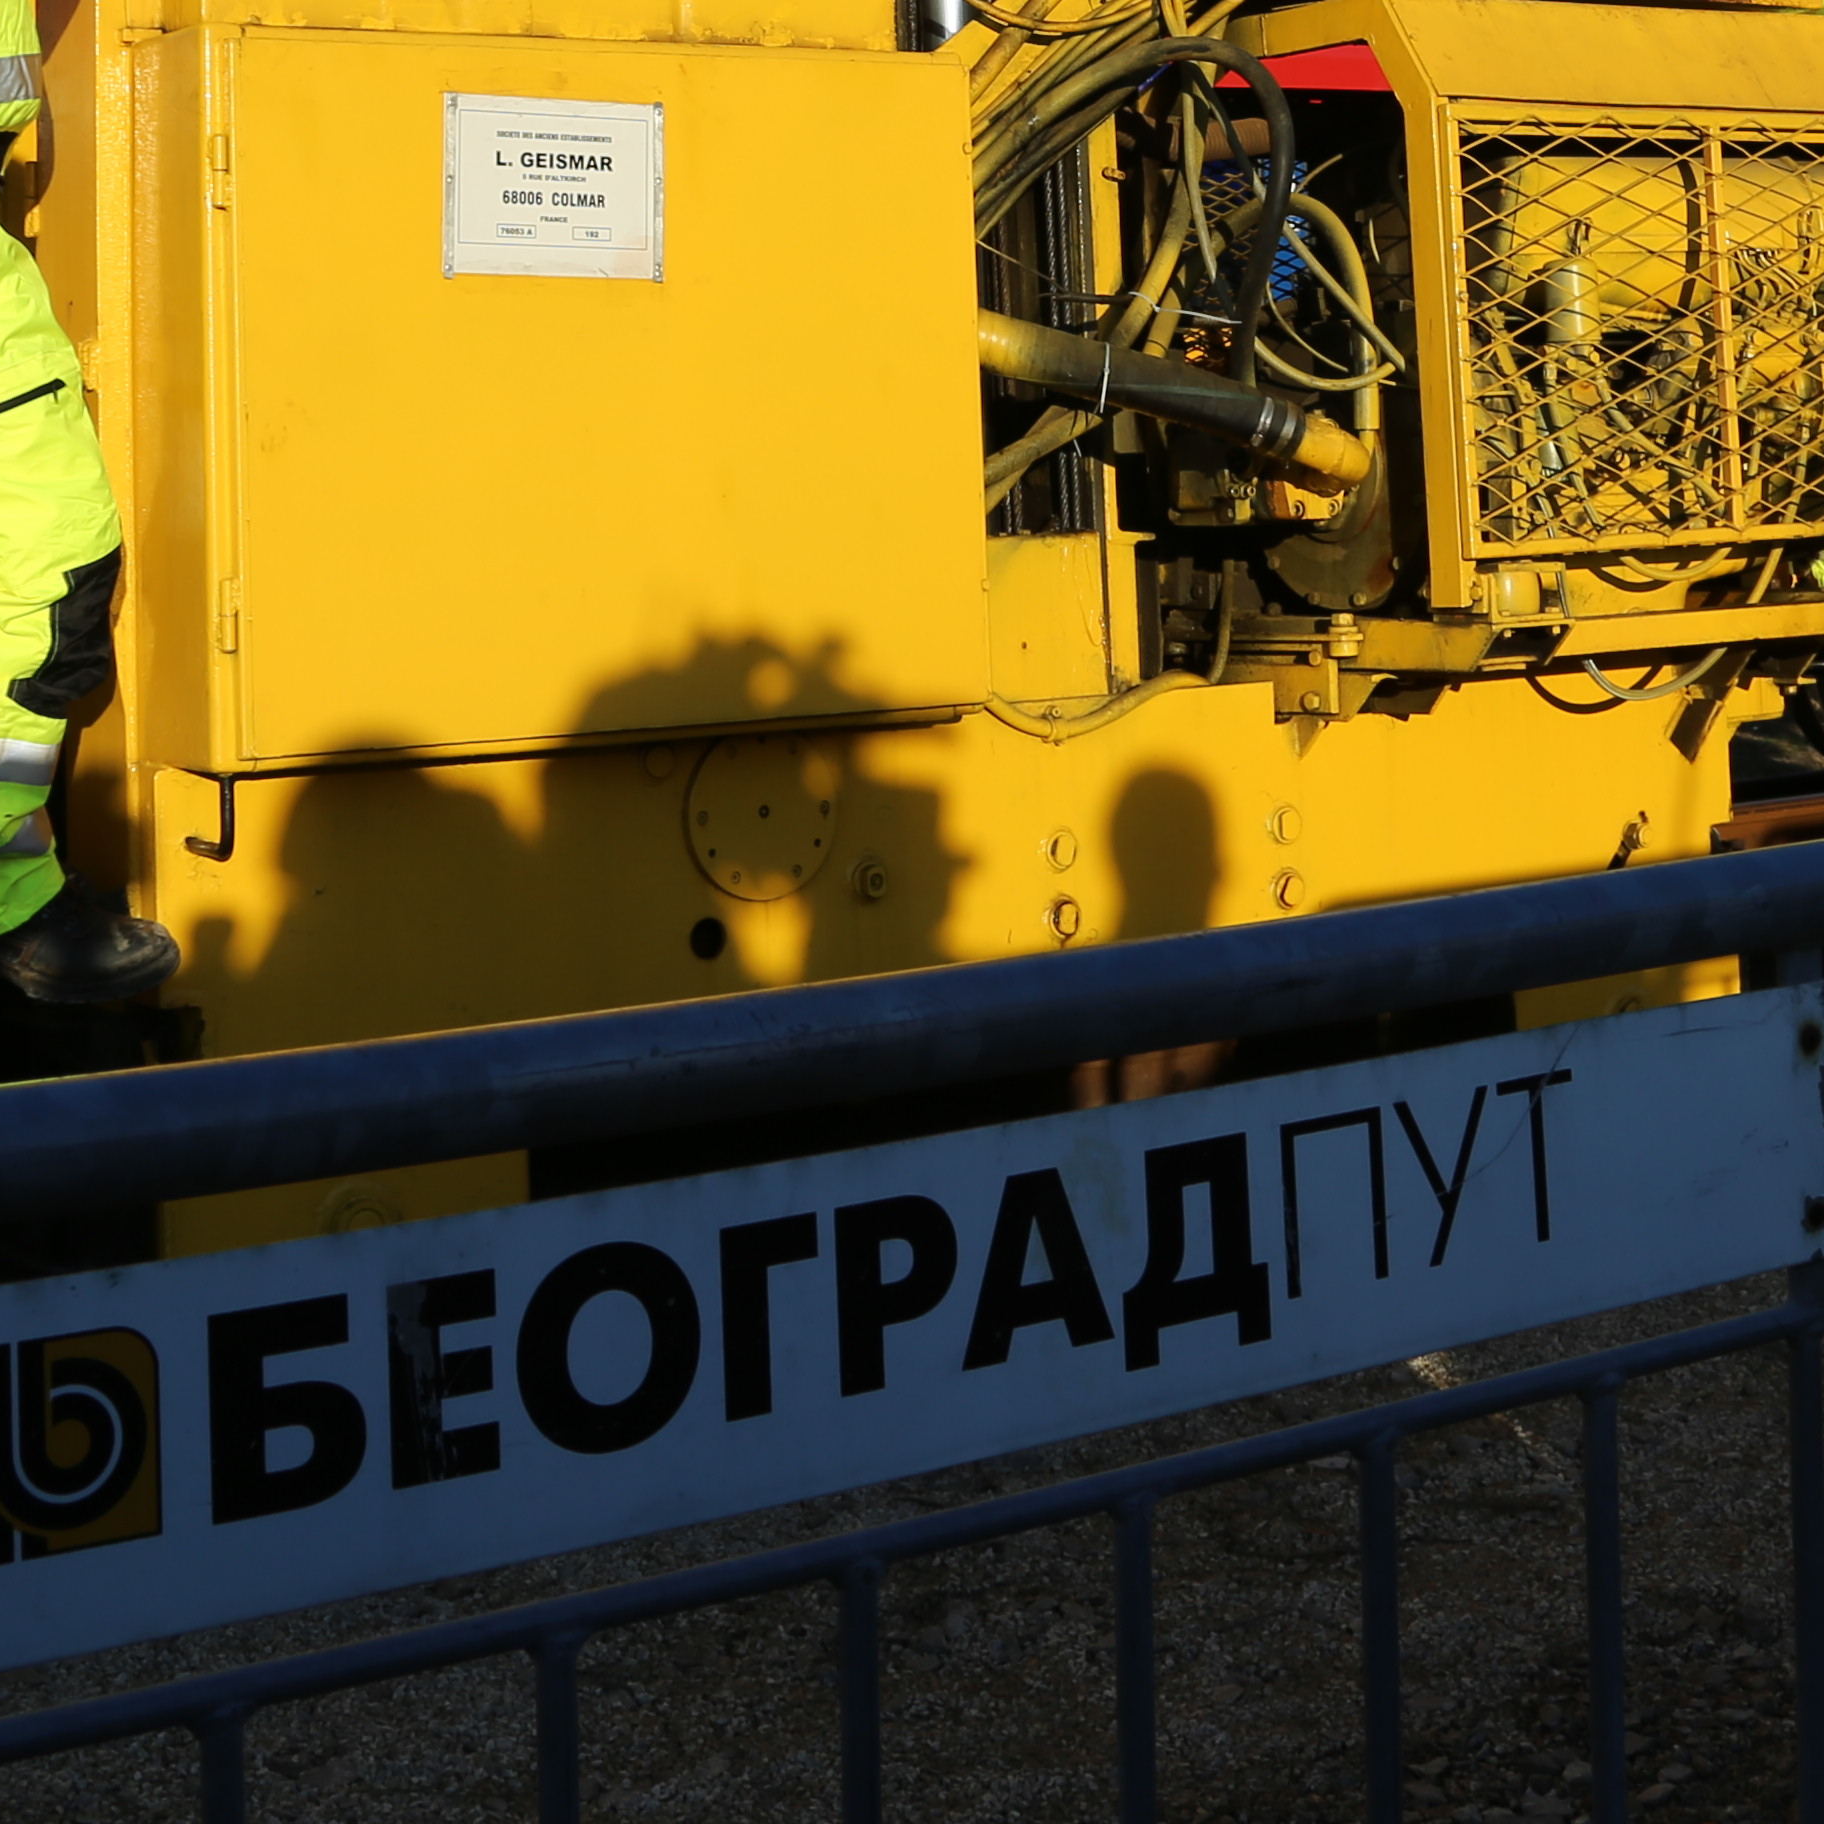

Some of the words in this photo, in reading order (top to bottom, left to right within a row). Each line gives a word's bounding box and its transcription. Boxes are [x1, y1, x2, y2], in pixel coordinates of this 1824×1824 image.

[496, 150, 513, 167] L.
[520, 152, 613, 172] GEISMAR
[502, 190, 543, 205] 68006
[551, 192, 606, 208] COLMAR
[208, 1069, 1574, 1526] БЕОГРАДПУТ
